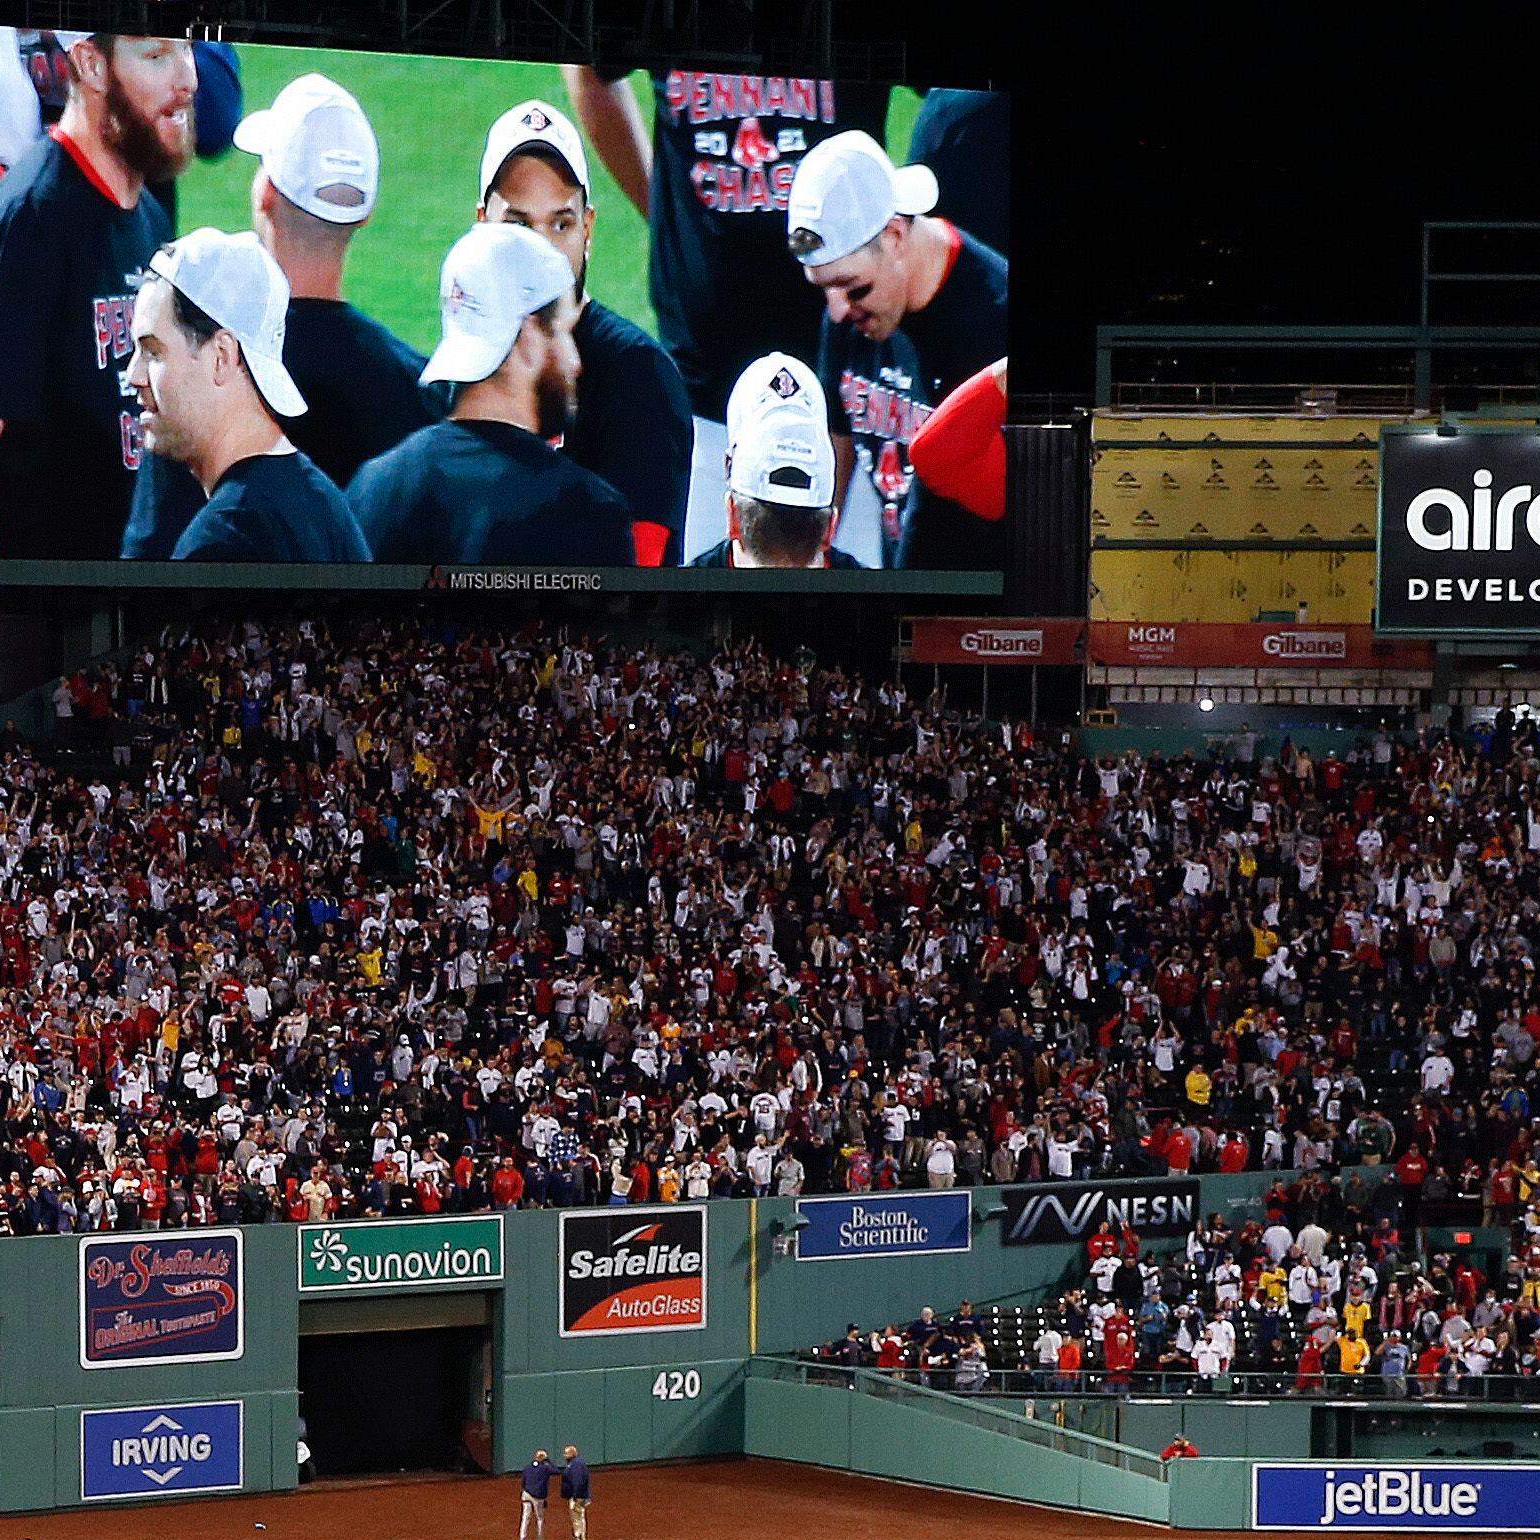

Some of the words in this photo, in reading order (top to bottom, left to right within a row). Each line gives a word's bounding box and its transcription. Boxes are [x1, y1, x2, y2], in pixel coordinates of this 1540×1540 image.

[690, 160, 798, 213] CHAS
[450, 573, 531, 590] MITSUBISHI
[533, 574, 602, 591] ELECTRIC
[961, 629, 1043, 655] Gilbane
[1128, 627, 1175, 642] MGM
[1262, 632, 1346, 657] Gilbane
[852, 1206, 909, 1227] Boston
[1107, 1195, 1193, 1226] NESN
[839, 1217, 930, 1248] Scientific
[346, 1242, 491, 1282] sunovion
[569, 1245, 701, 1279] Safelite
[606, 1293, 701, 1319] AutoGlass
[652, 1370, 701, 1400] 420
[112, 1434, 211, 1466] IRVING
[1320, 1470, 1478, 1525] jetBlue
